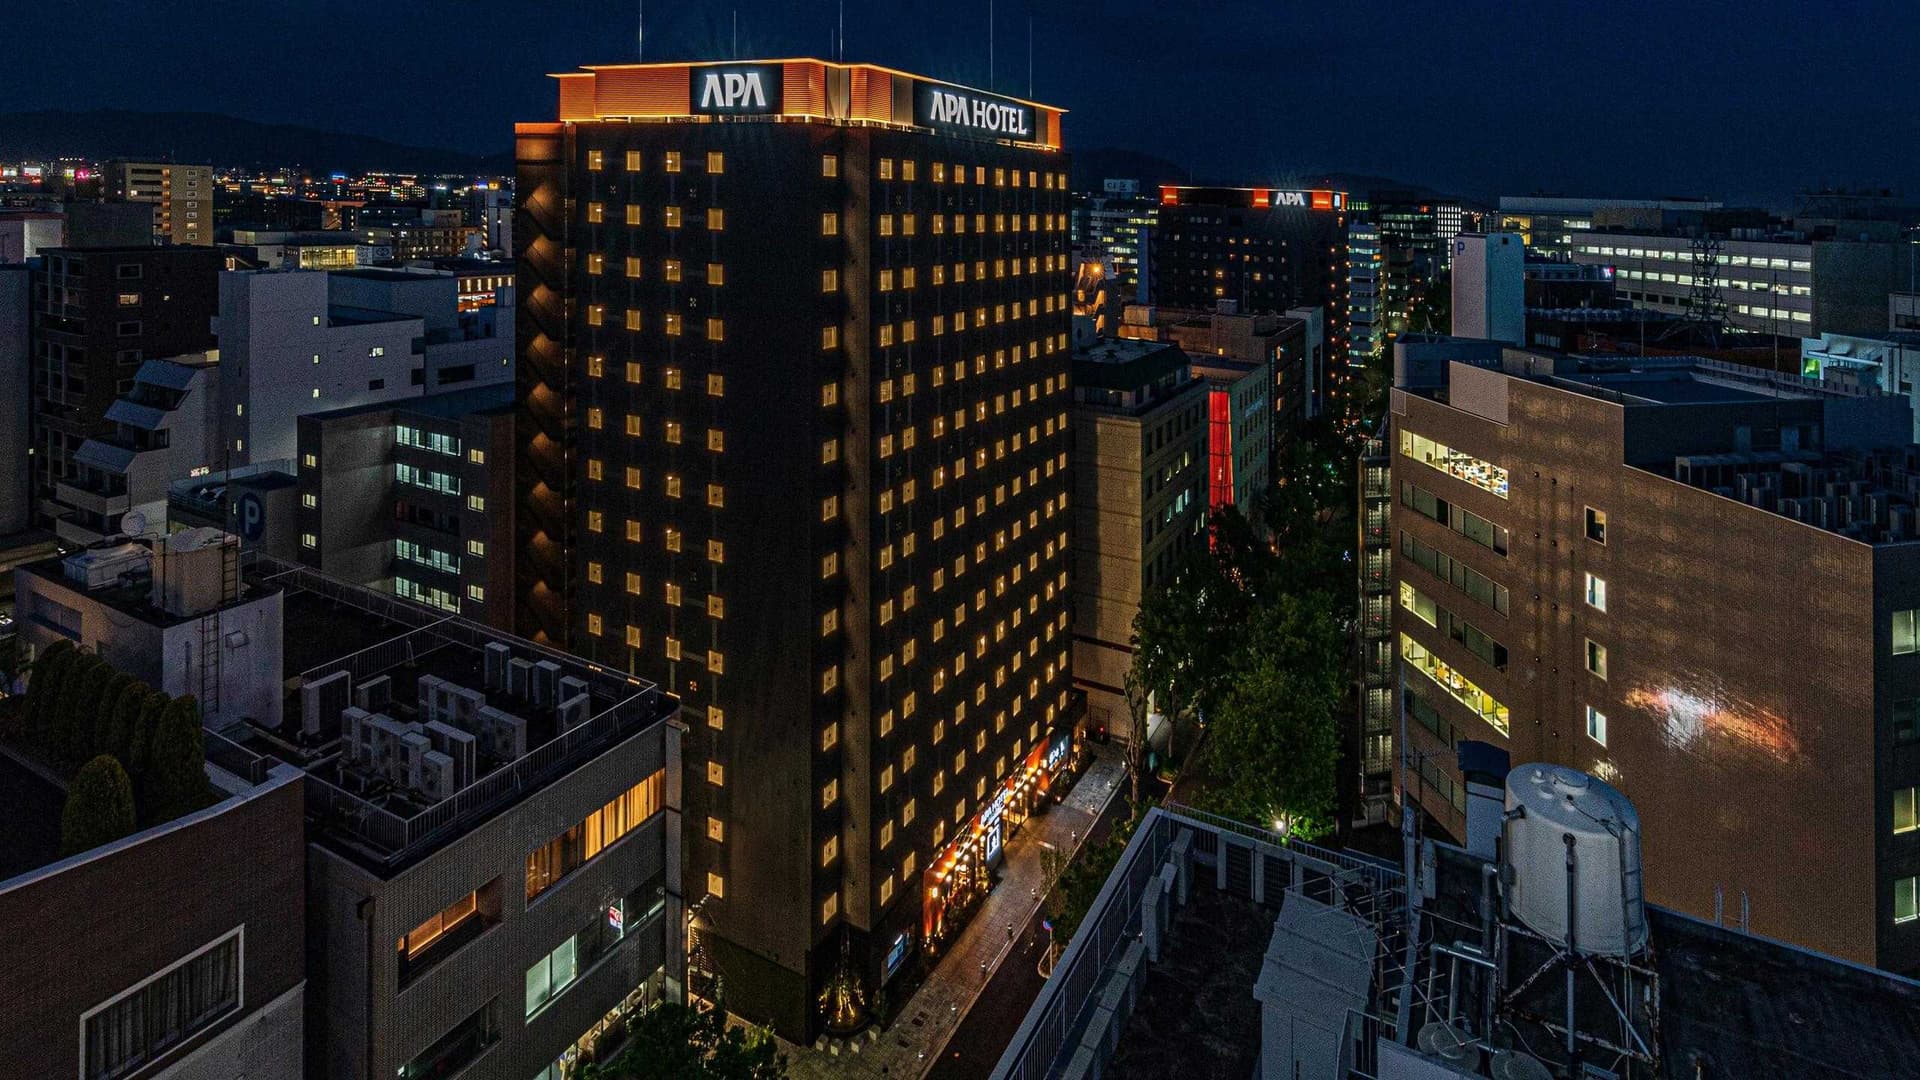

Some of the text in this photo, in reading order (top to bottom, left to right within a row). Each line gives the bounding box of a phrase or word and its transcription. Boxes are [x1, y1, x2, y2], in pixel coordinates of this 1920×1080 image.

[701, 73, 766, 107] APA
[930, 91, 1027, 135] APA HOTEL
[1275, 192, 1305, 206] APA
[1457, 242, 1466, 256] P
[244, 498, 261, 534] P
